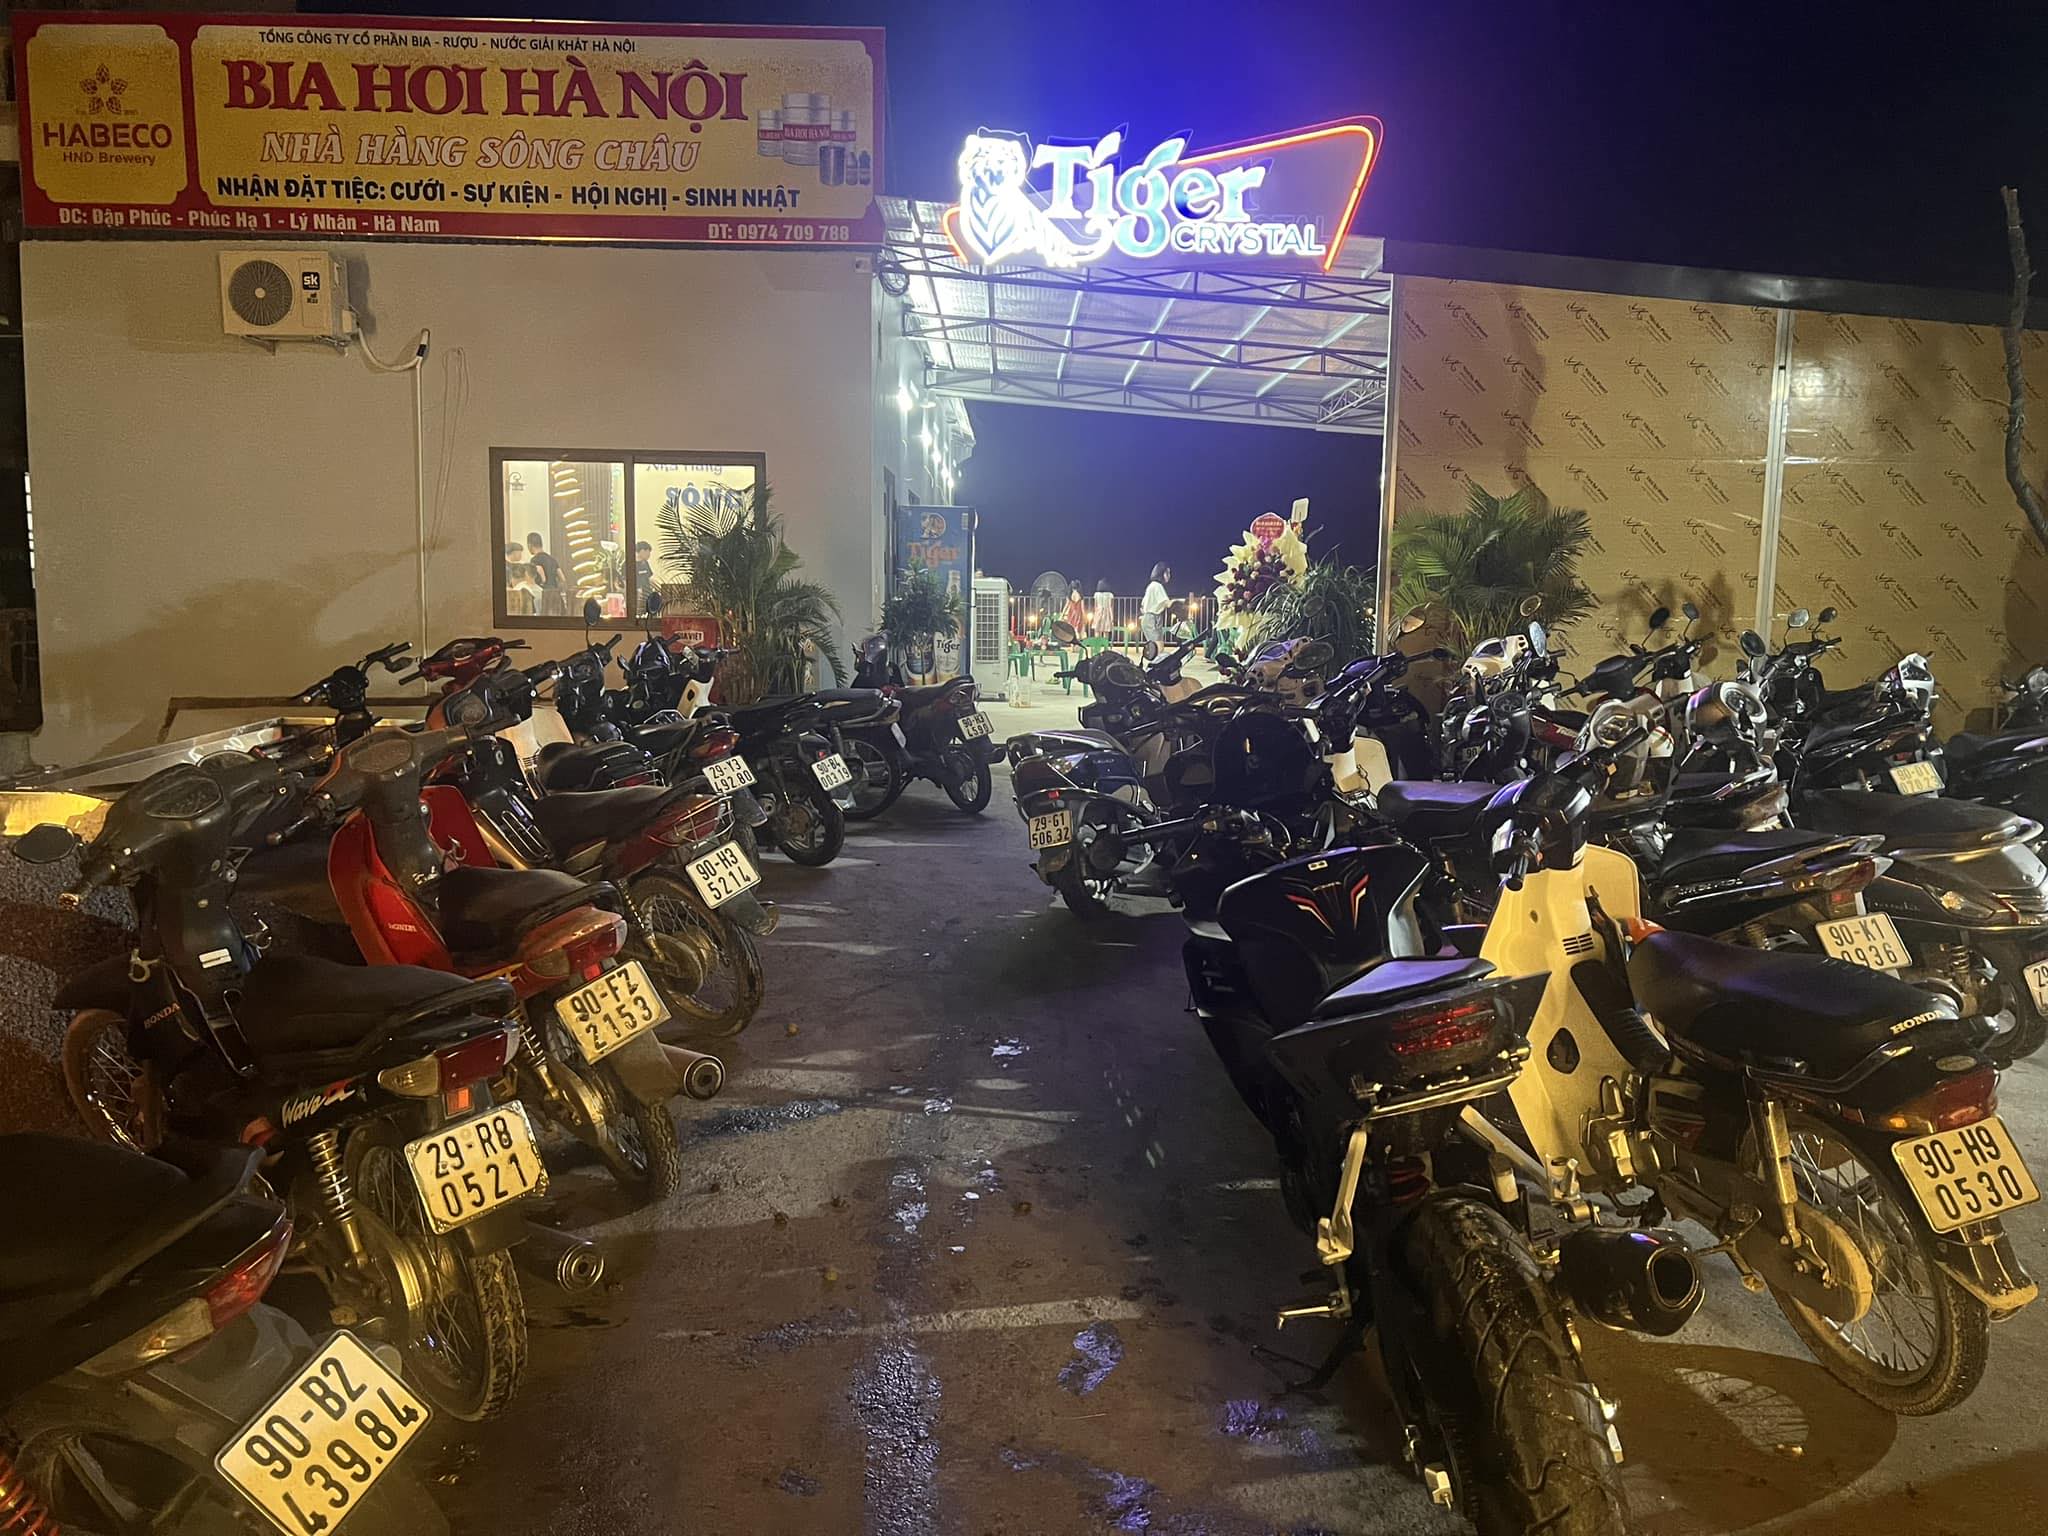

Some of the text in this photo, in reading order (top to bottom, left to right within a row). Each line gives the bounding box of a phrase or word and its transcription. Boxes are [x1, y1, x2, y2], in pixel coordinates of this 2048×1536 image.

[297, 30, 332, 44] CÔNG
[335, 33, 350, 45] TY
[411, 36, 431, 47] BIA
[443, 36, 478, 50] RƯỢU
[490, 35, 527, 50] NƯỚC
[592, 38, 610, 52] HÀ
[613, 39, 636, 54] NỘI
[221, 54, 749, 134] BIA HƠI HÀ NỘI
[42, 123, 173, 149] HABECO
[260, 123, 703, 173] NHÀ HÀNG SÔNG CHÂU
[63, 150, 156, 167] HND Brewery
[217, 173, 279, 202] NHẬN
[285, 174, 327, 202] ĐẶT
[331, 176, 386, 204] TIỆC:
[390, 177, 445, 201] CƯỚI
[463, 181, 496, 207] SỰ
[500, 180, 549, 208] KIỆN
[571, 182, 609, 210] HỘI
[614, 187, 667, 211] NGHỊ
[685, 187, 737, 207] SINH
[742, 184, 801, 213] NHẬT
[1032, 130, 1275, 260] Tiger
[58, 207, 88, 224] ĐC:
[129, 208, 171, 226] Phúc
[188, 210, 231, 227] Phúc
[235, 212, 257, 231] Hạ
[263, 213, 272, 228] 1
[290, 213, 308, 231] Lý
[313, 213, 357, 231] Nhân
[374, 215, 396, 232] Hà
[401, 216, 440, 233] Nam
[708, 222, 849, 241] ĐT: 0974 709 788
[1170, 221, 1327, 257] CRYSTAL
[303, 274, 319, 286] sk
[907, 539, 960, 568] Tiger
[936, 639, 961, 653] Tiger
[708, 758, 742, 779] 29-Y3
[1031, 826, 1070, 847] 506.32
[1034, 812, 1065, 832] 29-G1
[695, 847, 738, 881] 90-H3
[706, 866, 751, 900] 5214
[1828, 917, 1885, 947] 90-K1
[143, 1001, 182, 1030] HONDA
[585, 996, 653, 1050] 2153
[1889, 1008, 1946, 1036] HONDA
[426, 1115, 513, 1179] 29-R8
[1913, 1125, 2001, 1179] 90-H9
[441, 1153, 528, 1217] 0521
[1935, 1165, 2023, 1221] 0530
[244, 1356, 369, 1480] 90-B2
[281, 1386, 420, 1536] 439.84
